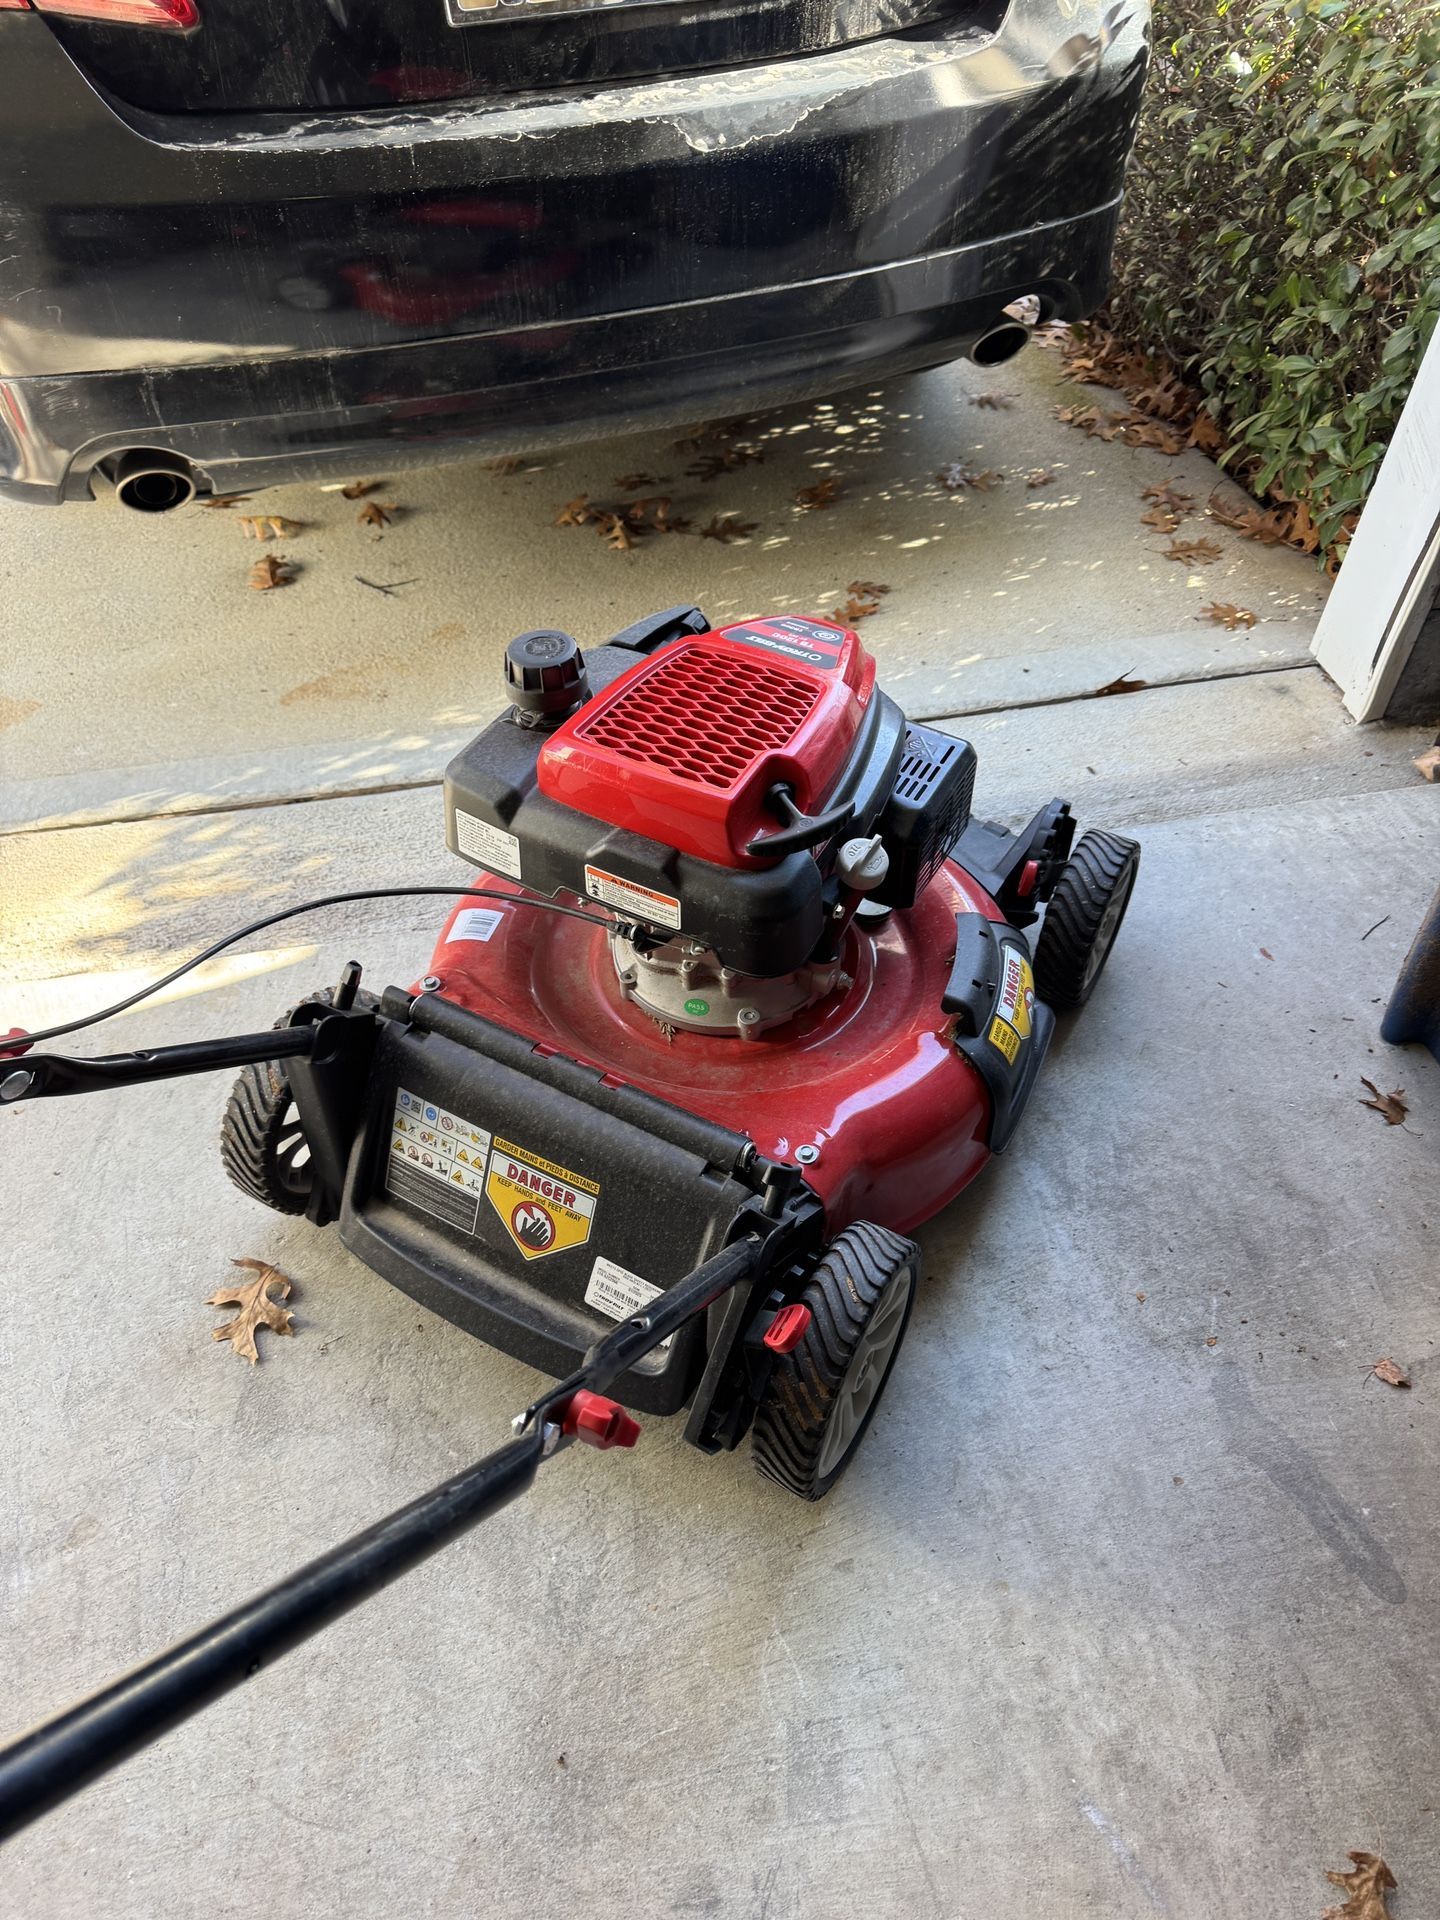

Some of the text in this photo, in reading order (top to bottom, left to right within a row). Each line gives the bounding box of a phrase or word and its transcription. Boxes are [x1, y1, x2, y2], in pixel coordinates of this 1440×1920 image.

[848, 844, 862, 858] OIL
[620, 881, 654, 898] WARNING
[688, 1002, 705, 1011] PASS
[1003, 959, 1020, 1009] DANGER
[495, 1138, 519, 1156] GARDER
[520, 1149, 539, 1165] MAINS
[539, 1159, 545, 1168] et
[545, 1161, 564, 1176] PIEDS
[569, 1172, 600, 1193] DISTANCE
[507, 1163, 577, 1208] DANGER
[497, 1176, 582, 1222] KEEP HANDS and FEET AWAY
